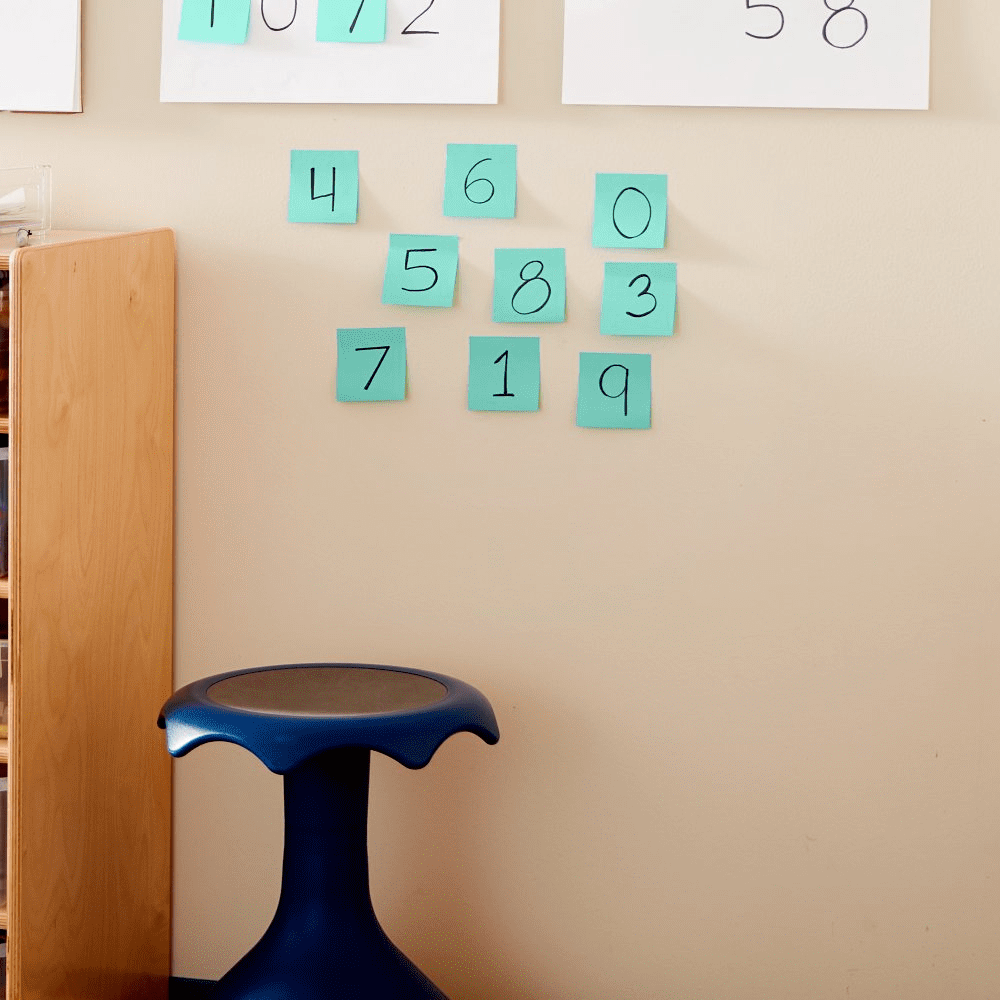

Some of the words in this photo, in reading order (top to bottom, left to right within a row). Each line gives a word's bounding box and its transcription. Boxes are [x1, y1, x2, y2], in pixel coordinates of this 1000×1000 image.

[310, 166, 336, 212] 4
[464, 158, 495, 204] 6
[612, 187, 652, 239] 0
[401, 248, 438, 292] 5
[511, 260, 552, 315] 8
[625, 274, 657, 318] 3
[355, 345, 391, 391] 7
[492, 349, 515, 397] 1
[599, 364, 629, 417] 9
